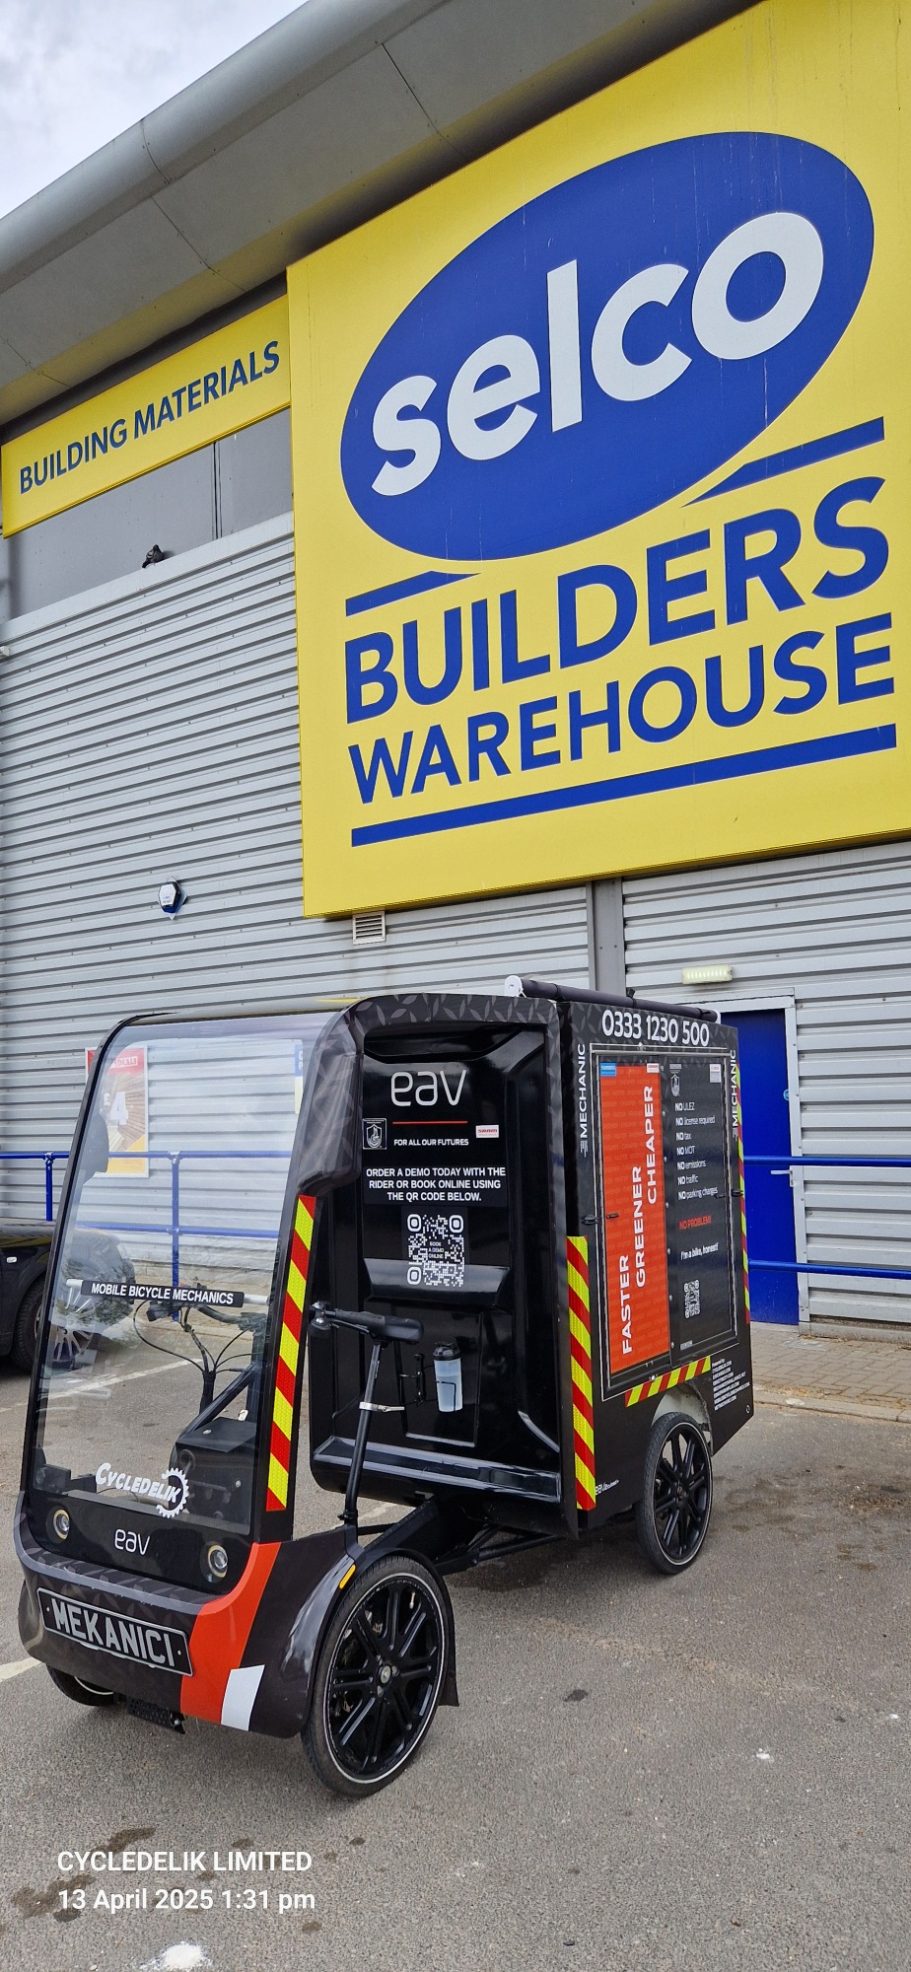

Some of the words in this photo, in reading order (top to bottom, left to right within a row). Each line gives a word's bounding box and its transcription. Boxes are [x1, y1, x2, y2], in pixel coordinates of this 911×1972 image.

[371, 211, 824, 497] selco
[19, 418, 128, 494] BUILDING
[133, 340, 280, 440] MATERIALS
[345, 476, 889, 725] BUILDERS
[348, 612, 896, 805] WAREHOUSE
[601, 1009, 642, 1039] 0333
[646, 1015, 679, 1043] 1230
[682, 1021, 710, 1047] 500
[390, 1069, 467, 1106] eav
[577, 1043, 588, 1139] MECHANIC
[730, 1049, 739, 1127] MECHANIC
[675, 1102, 683, 1112] NO
[676, 1117, 683, 1126] NO
[394, 1138, 408, 1146] FOR
[408, 1138, 421, 1146] ALL
[422, 1138, 436, 1146] OUR
[438, 1138, 470, 1146] FUTURES
[643, 1086, 658, 1204] CHEAPER
[676, 1132, 684, 1140] NO
[677, 1147, 684, 1156] NO
[366, 1168, 395, 1177] ORDER
[397, 1168, 404, 1176] A
[405, 1168, 430, 1176] DEMO
[432, 1168, 461, 1176] TODAY
[463, 1167, 485, 1176] WITH
[487, 1167, 506, 1176] THE
[677, 1162, 685, 1170] NO
[369, 1180, 394, 1189] RIDER
[396, 1180, 409, 1189] OR
[410, 1180, 436, 1189] BOOK
[438, 1180, 471, 1189] ONLINE
[472, 1180, 501, 1189] USING
[678, 1176, 685, 1185] NO
[387, 1192, 404, 1200] THE
[406, 1192, 419, 1202] QR
[421, 1192, 445, 1200] CODE
[447, 1192, 482, 1201] BELOW.
[678, 1191, 686, 1200] NO
[632, 1166, 646, 1289] GREENER
[92, 1283, 126, 1296] MOBILE
[128, 1285, 171, 1299] BICYCLE
[172, 1289, 234, 1304] MECHANICS
[619, 1255, 633, 1354] FASTER
[114, 1529, 150, 1555] eav
